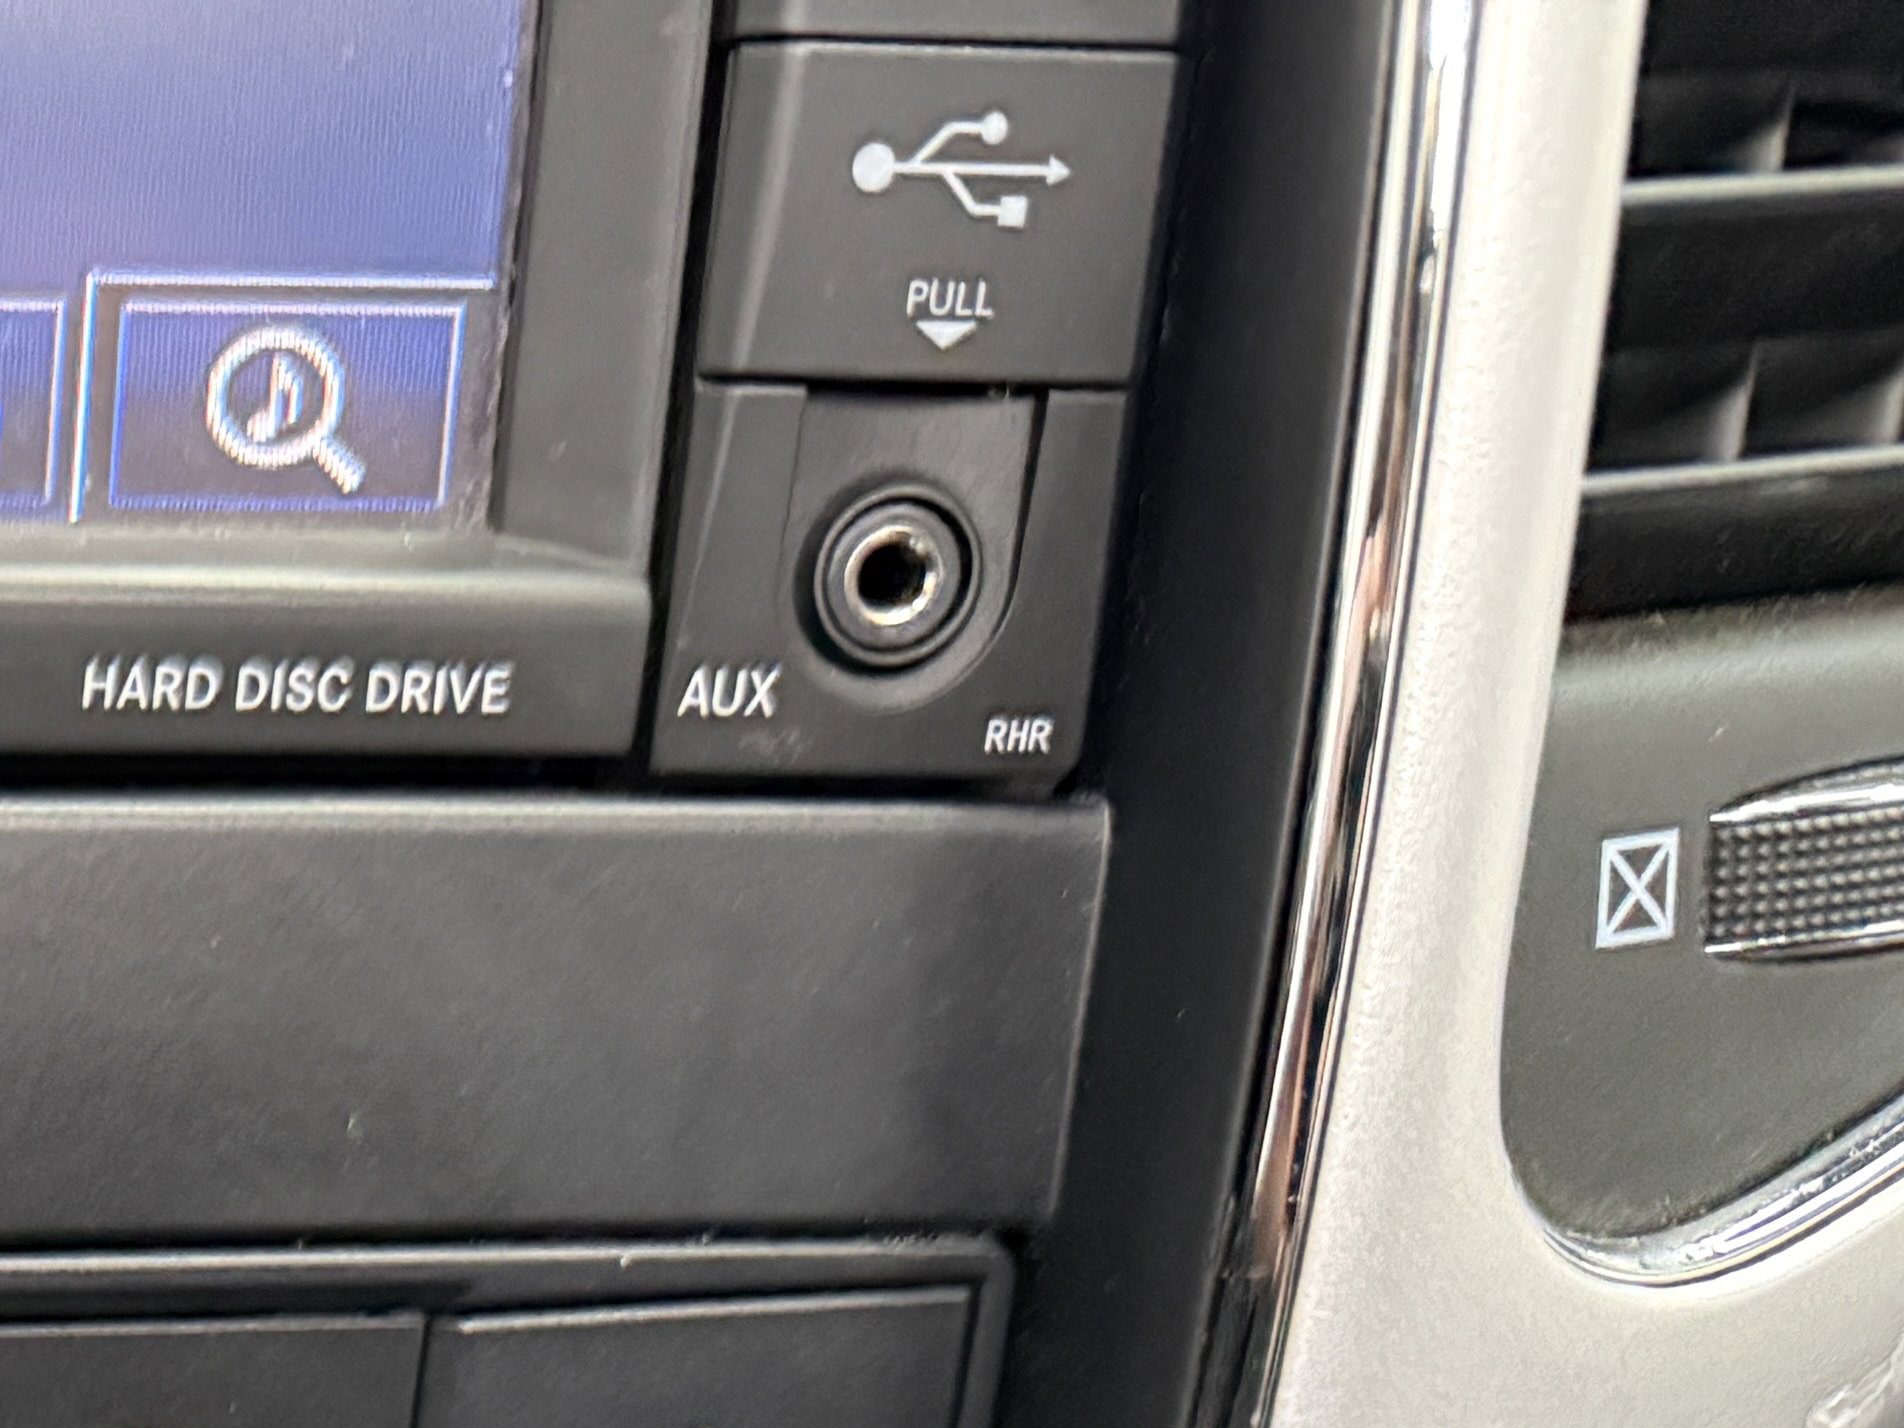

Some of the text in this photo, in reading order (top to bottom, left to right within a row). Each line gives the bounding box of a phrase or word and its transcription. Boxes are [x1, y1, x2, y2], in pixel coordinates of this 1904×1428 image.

[905, 279, 996, 320] PULL
[82, 658, 512, 714] HARD DISC DRIVE
[677, 666, 780, 717] AUX
[984, 717, 1053, 753] RHR
